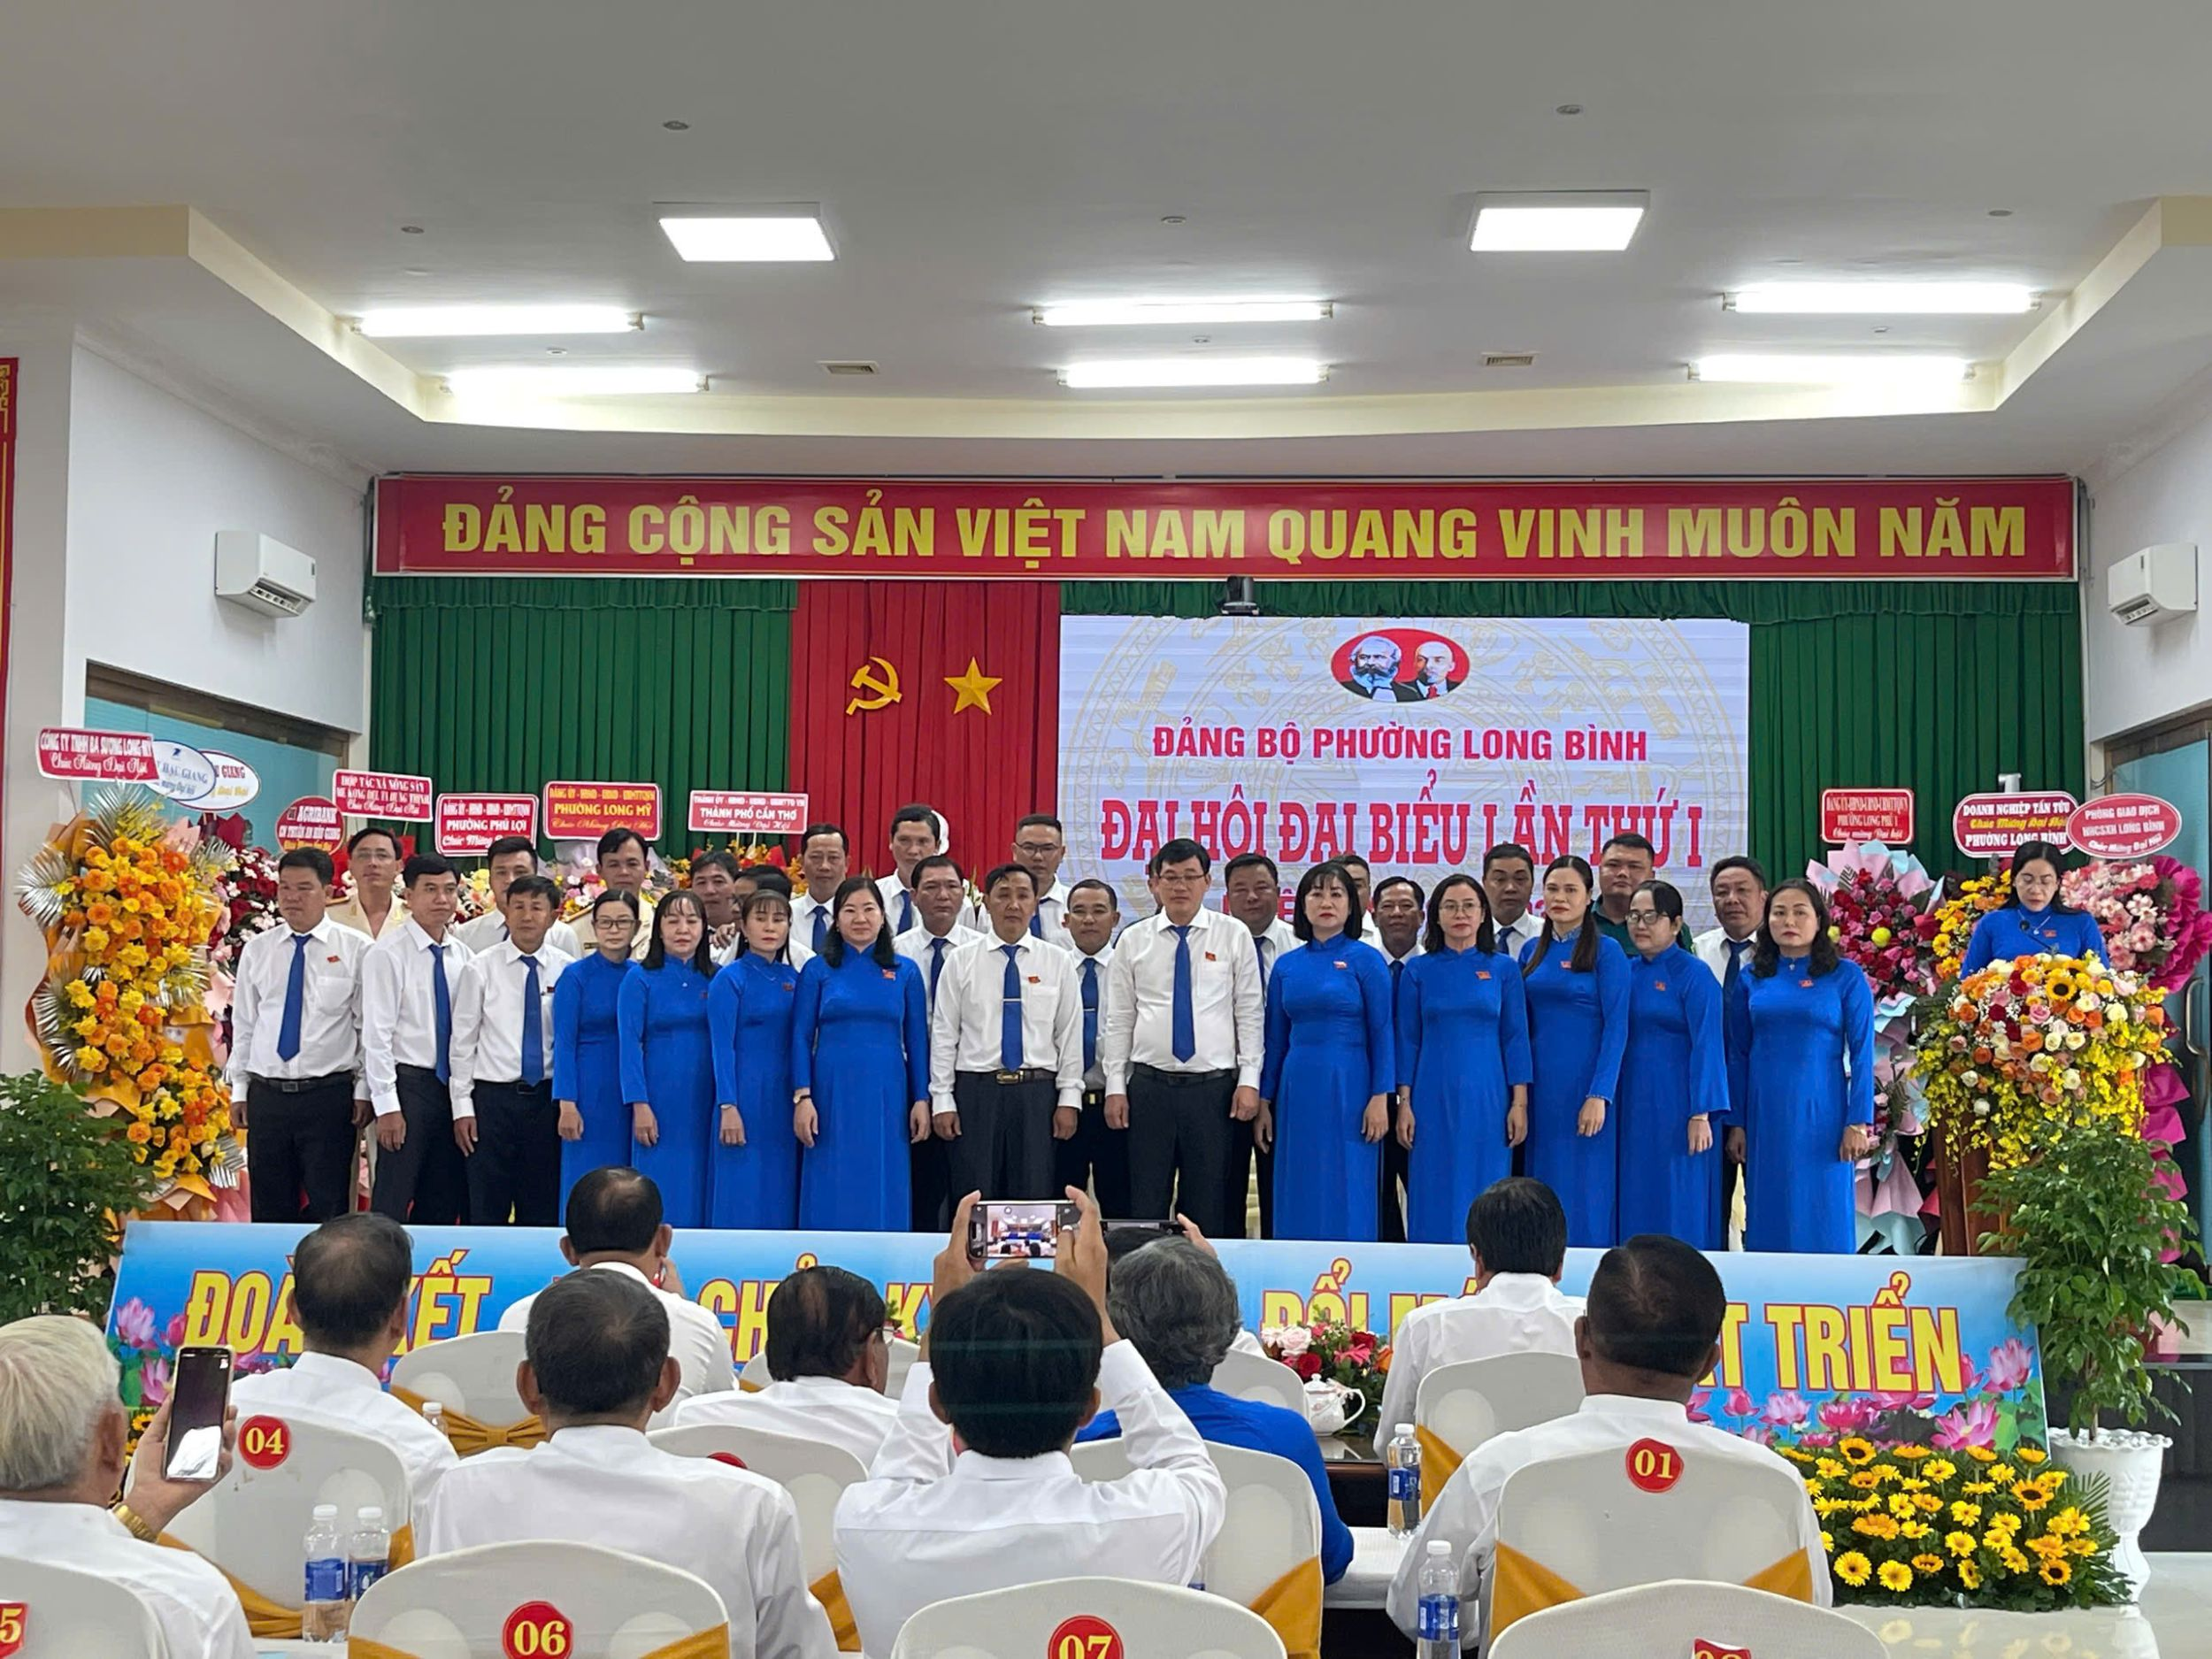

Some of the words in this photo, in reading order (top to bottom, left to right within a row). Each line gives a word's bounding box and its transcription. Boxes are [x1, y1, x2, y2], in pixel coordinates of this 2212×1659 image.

[443, 486, 606, 555] ĐẢNG
[628, 496, 790, 565] CỘNG
[812, 488, 934, 557] SẢN
[956, 497, 1087, 569] VIỆT
[1107, 510, 1245, 558] NAM
[1269, 509, 1478, 565] QUANG
[1500, 509, 1642, 558] VINH
[1667, 496, 1854, 558] MUÔN
[1879, 496, 2025, 558] NĂM
[1152, 717, 1245, 758] ĐẢNG
[1257, 720, 1300, 764] BỘ
[1313, 720, 1451, 759] PHƯỜNG
[1463, 729, 1552, 760] LONG
[1564, 724, 1647, 760] BÌNH
[554, 802, 601, 815] PHƯỜNG
[603, 804, 634, 816] LONG
[636, 803, 652, 816] MỸ
[700, 806, 733, 818] THÀNH
[734, 805, 754, 819] PHỐ
[756, 806, 775, 820] CẦN
[777, 809, 797, 821] THƠ
[1369, 769, 1471, 864] BIỂU
[1483, 780, 1573, 864] LẦN
[1585, 787, 1678, 867] THỨ
[1687, 806, 1702, 867] I
[1962, 804, 1994, 816] DOANH
[1996, 801, 2031, 817] NGHIỆP
[2085, 806, 2115, 820] PHÒNG
[2116, 806, 2137, 818] GIAO
[446, 818, 488, 831] PHƯỜNG
[2118, 823, 2141, 834] LONG
[1965, 832, 2008, 847] PHƯỜNG
[183, 1255, 306, 1356] ĐOÀ
[1764, 1271, 1964, 1394] TRIỂN
[246, 1427, 284, 1455] 04
[1635, 1449, 1673, 1479] 01
[514, 1621, 566, 1655] 06
[1059, 1635, 1112, 1659] 07
